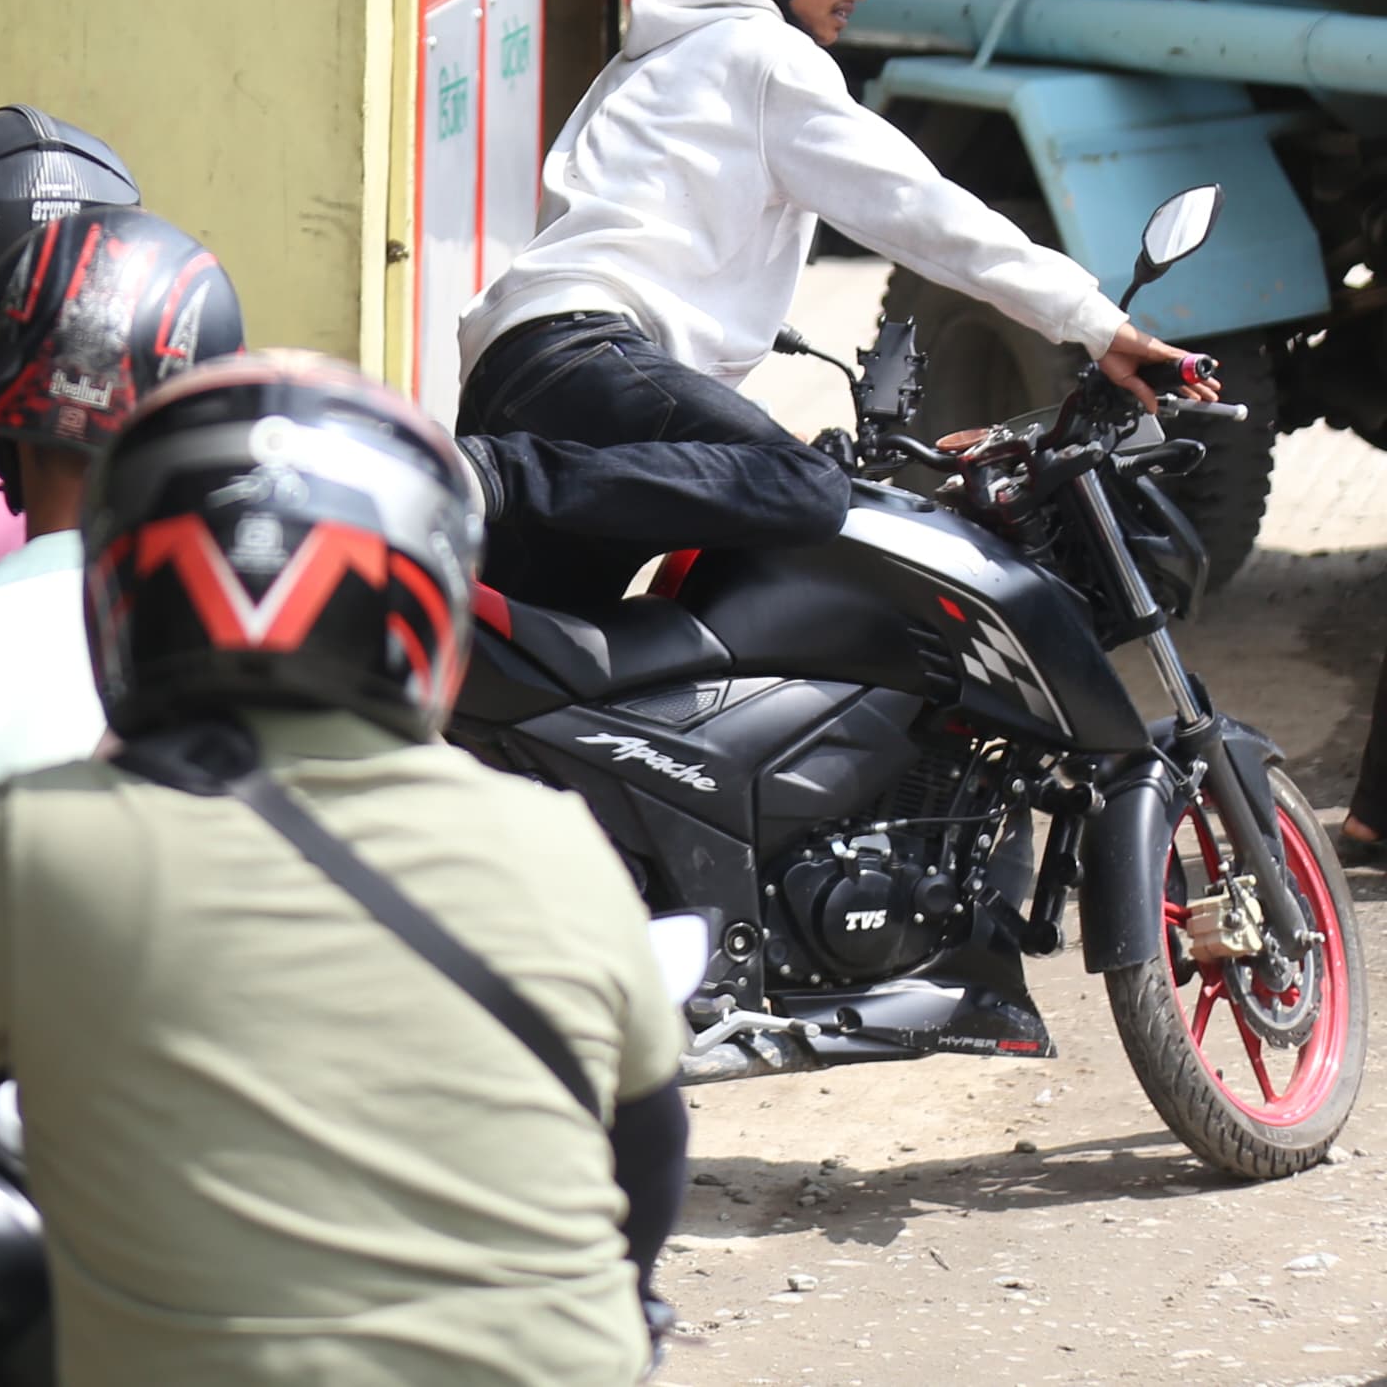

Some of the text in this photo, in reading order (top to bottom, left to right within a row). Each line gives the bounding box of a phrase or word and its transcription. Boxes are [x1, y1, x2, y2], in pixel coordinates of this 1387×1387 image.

[575, 732, 719, 792] Apache
[845, 909, 887, 931] TVS
[938, 1035, 997, 1048] HYPER
